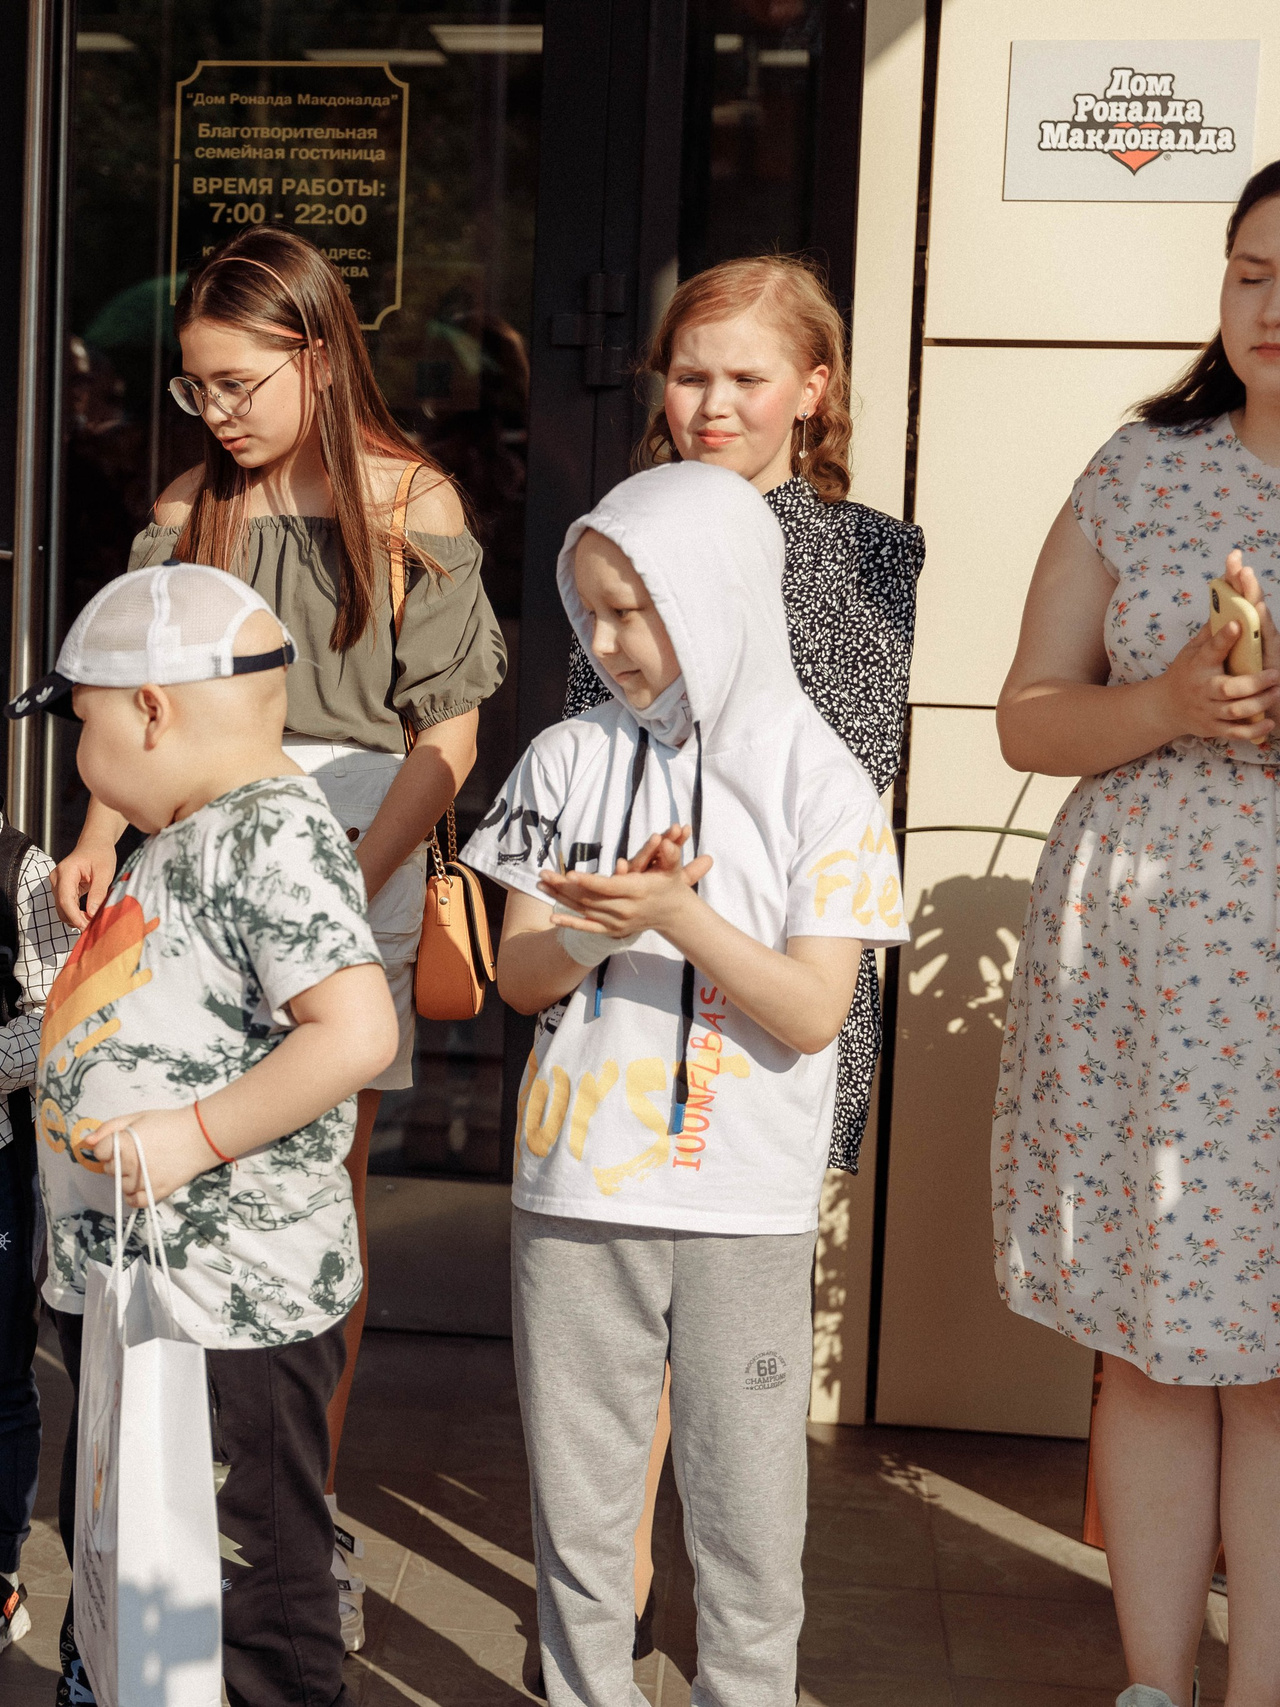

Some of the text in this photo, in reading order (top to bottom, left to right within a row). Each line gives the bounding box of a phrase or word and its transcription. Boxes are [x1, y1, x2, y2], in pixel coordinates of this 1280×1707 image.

[1106, 69, 1173, 98] Дом
[230, 93, 292, 106] Роналда
[1074, 95, 1202, 124] Роналда
[198, 123, 377, 141] Благотворительная
[1040, 122, 1235, 152] Макдоналда
[195, 144, 386, 162] семейная гостиница
[193, 177, 386, 197] ВРЕМЯ РАБОТЫ:
[209, 202, 265, 224] 7:00
[294, 204, 367, 225] 22:00
[757, 1358, 777, 1376] 68
